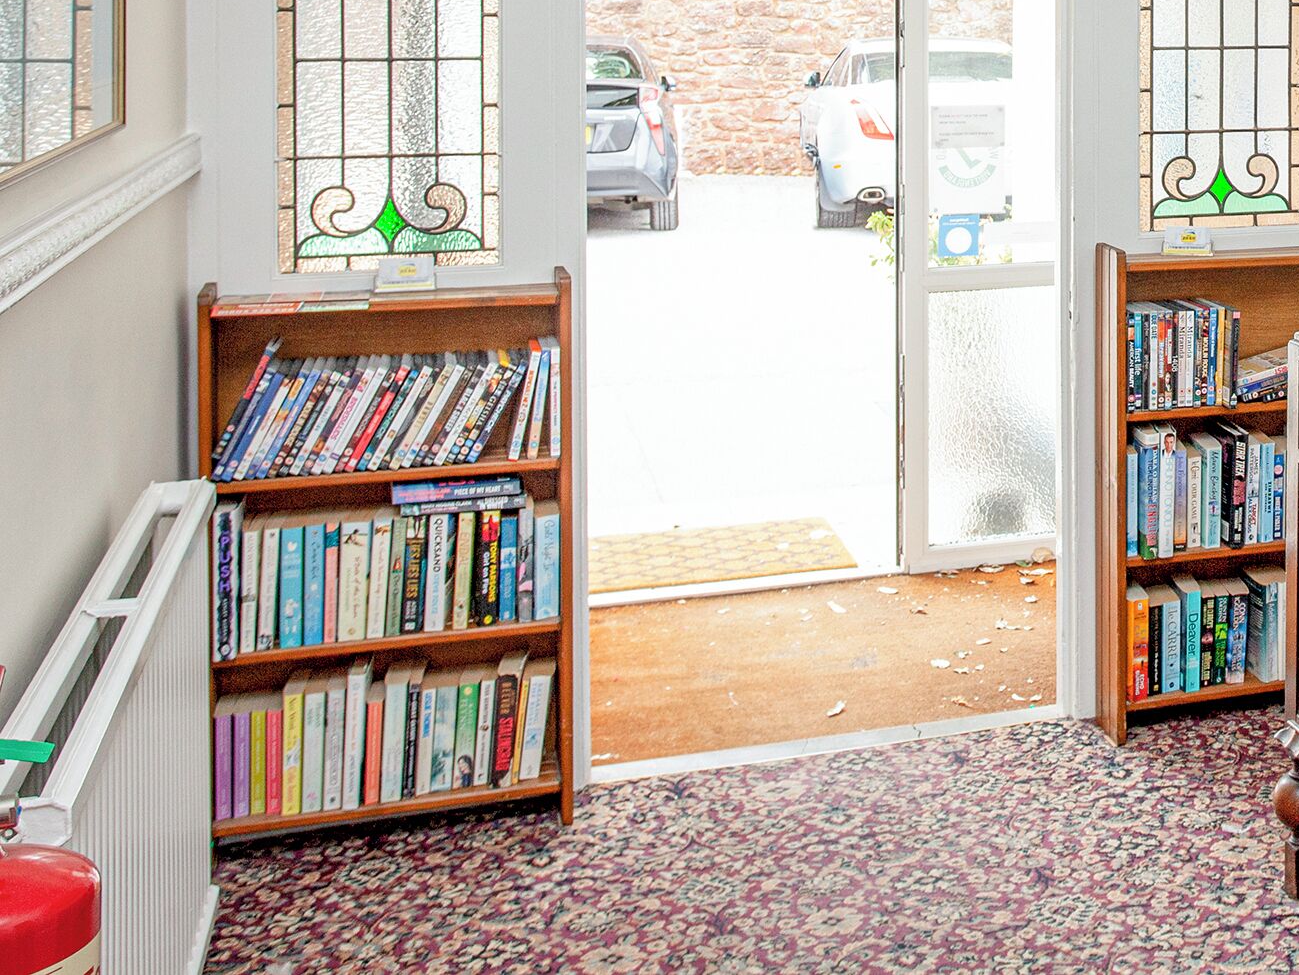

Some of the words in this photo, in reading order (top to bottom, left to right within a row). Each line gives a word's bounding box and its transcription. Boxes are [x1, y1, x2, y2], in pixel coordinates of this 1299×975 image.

[475, 395, 499, 428] GEISHA
[1235, 460, 1245, 477] TREK
[1236, 442, 1245, 460] STAR
[1209, 475, 1219, 501] Binchy
[1146, 504, 1157, 546] ENGLISH
[219, 531, 231, 592] PUSH
[432, 518, 444, 573] QUICKSAND
[488, 565, 497, 603] PARSONS
[1188, 613, 1199, 656] Deaver
